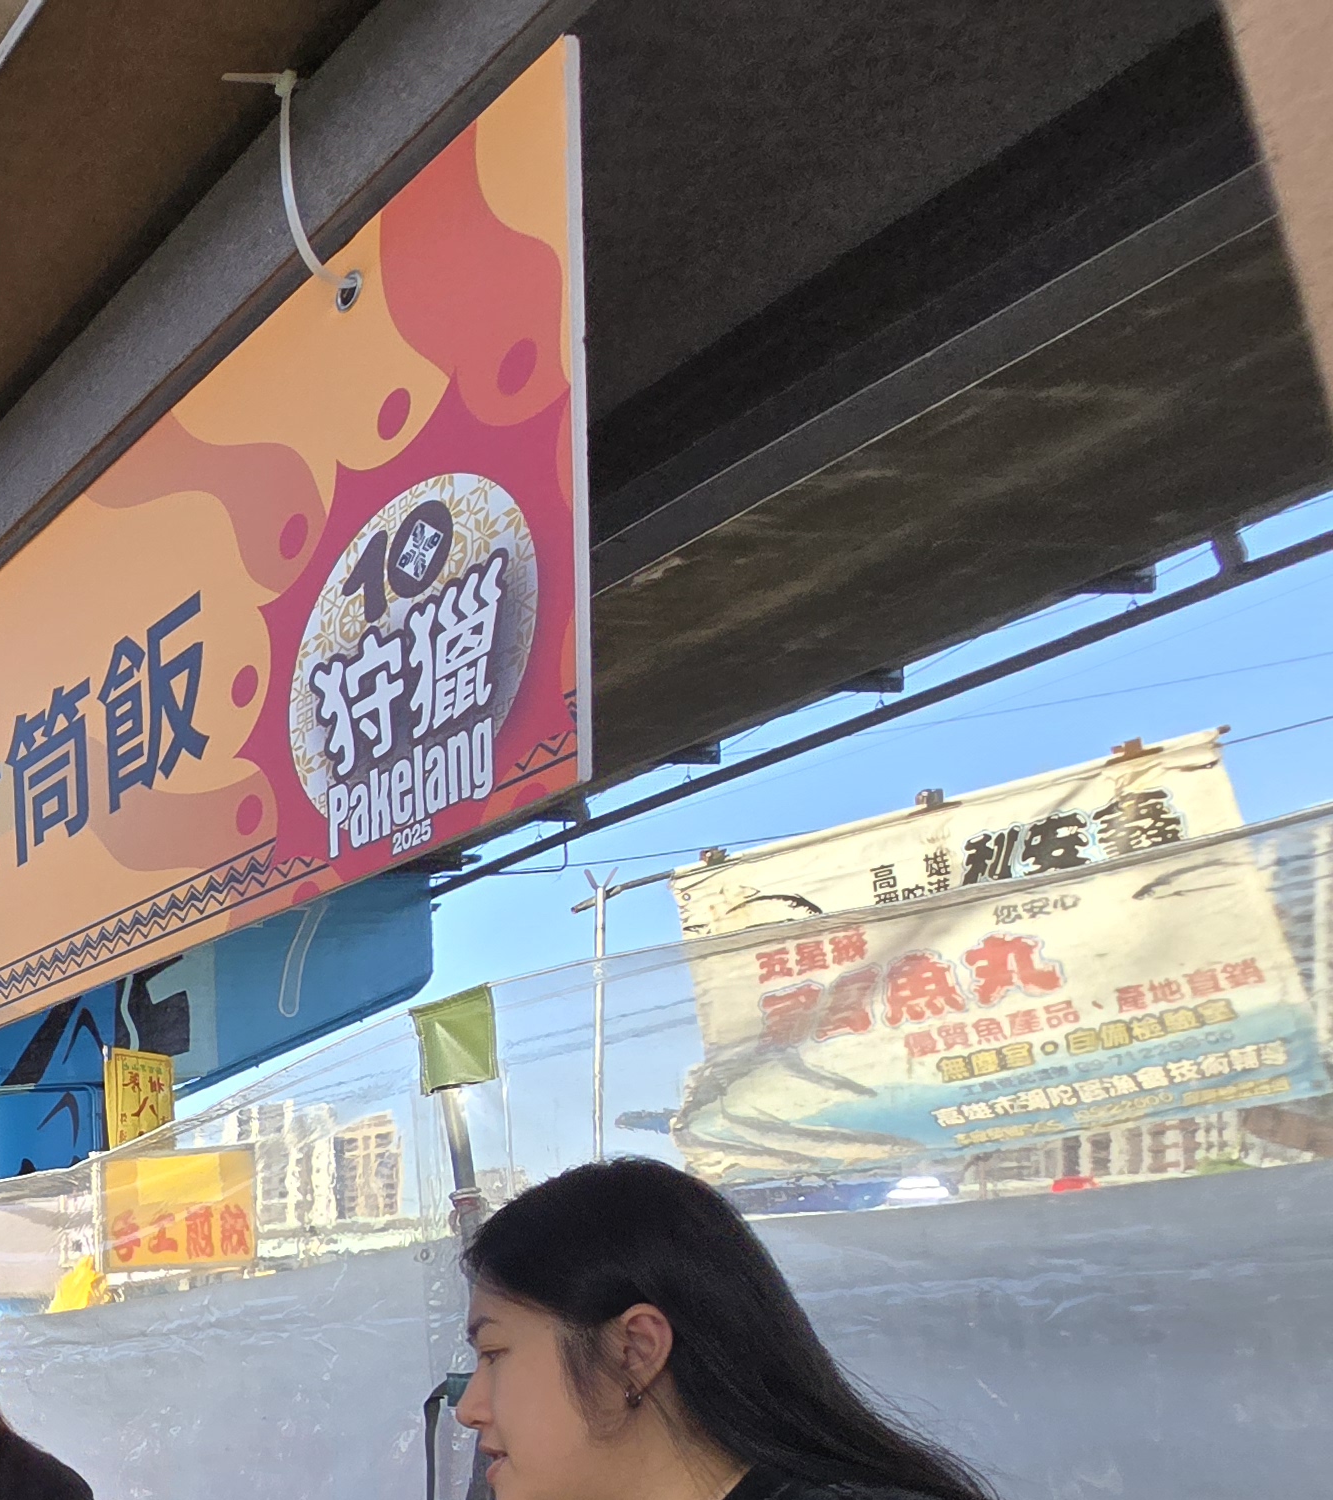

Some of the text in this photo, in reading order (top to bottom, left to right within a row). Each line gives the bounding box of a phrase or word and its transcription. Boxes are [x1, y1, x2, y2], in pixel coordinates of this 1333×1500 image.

[342, 500, 453, 623] 10
[312, 552, 506, 778] 狩獵
[328, 717, 495, 858] Pakelang
[392, 819, 431, 855] 2025
[870, 851, 950, 893] 高雄
